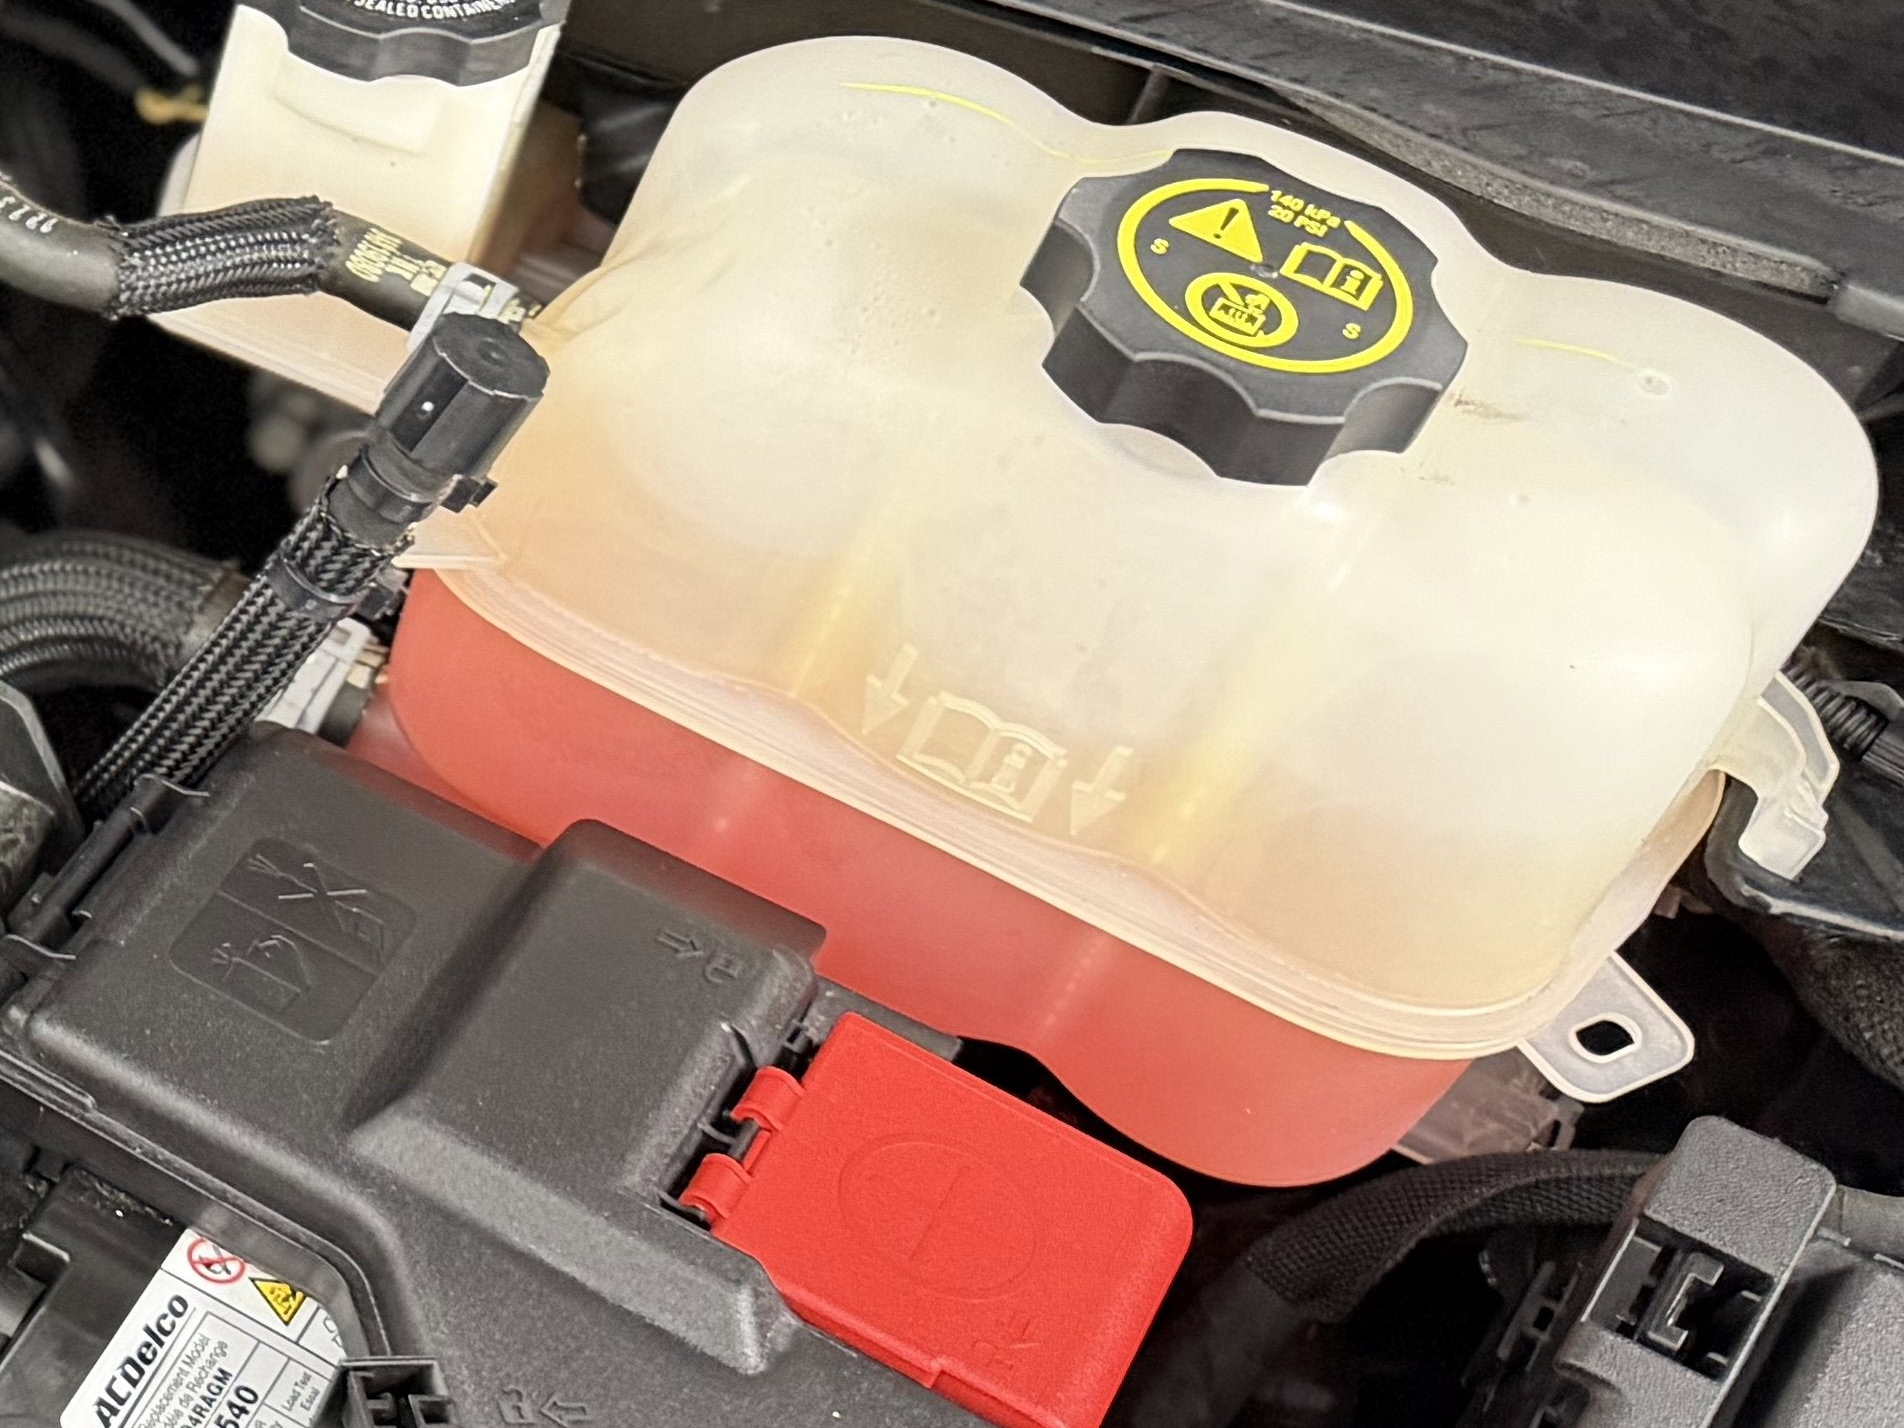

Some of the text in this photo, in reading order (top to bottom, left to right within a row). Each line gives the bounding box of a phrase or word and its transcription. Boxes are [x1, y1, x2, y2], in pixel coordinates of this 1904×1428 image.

[1268, 205, 1328, 237] 20 PSI
[1271, 190, 1340, 228] 140 kPa
[181, 1335, 210, 1368] Model
[179, 1394, 194, 1408] de
[282, 1372, 312, 1412] Load Test
